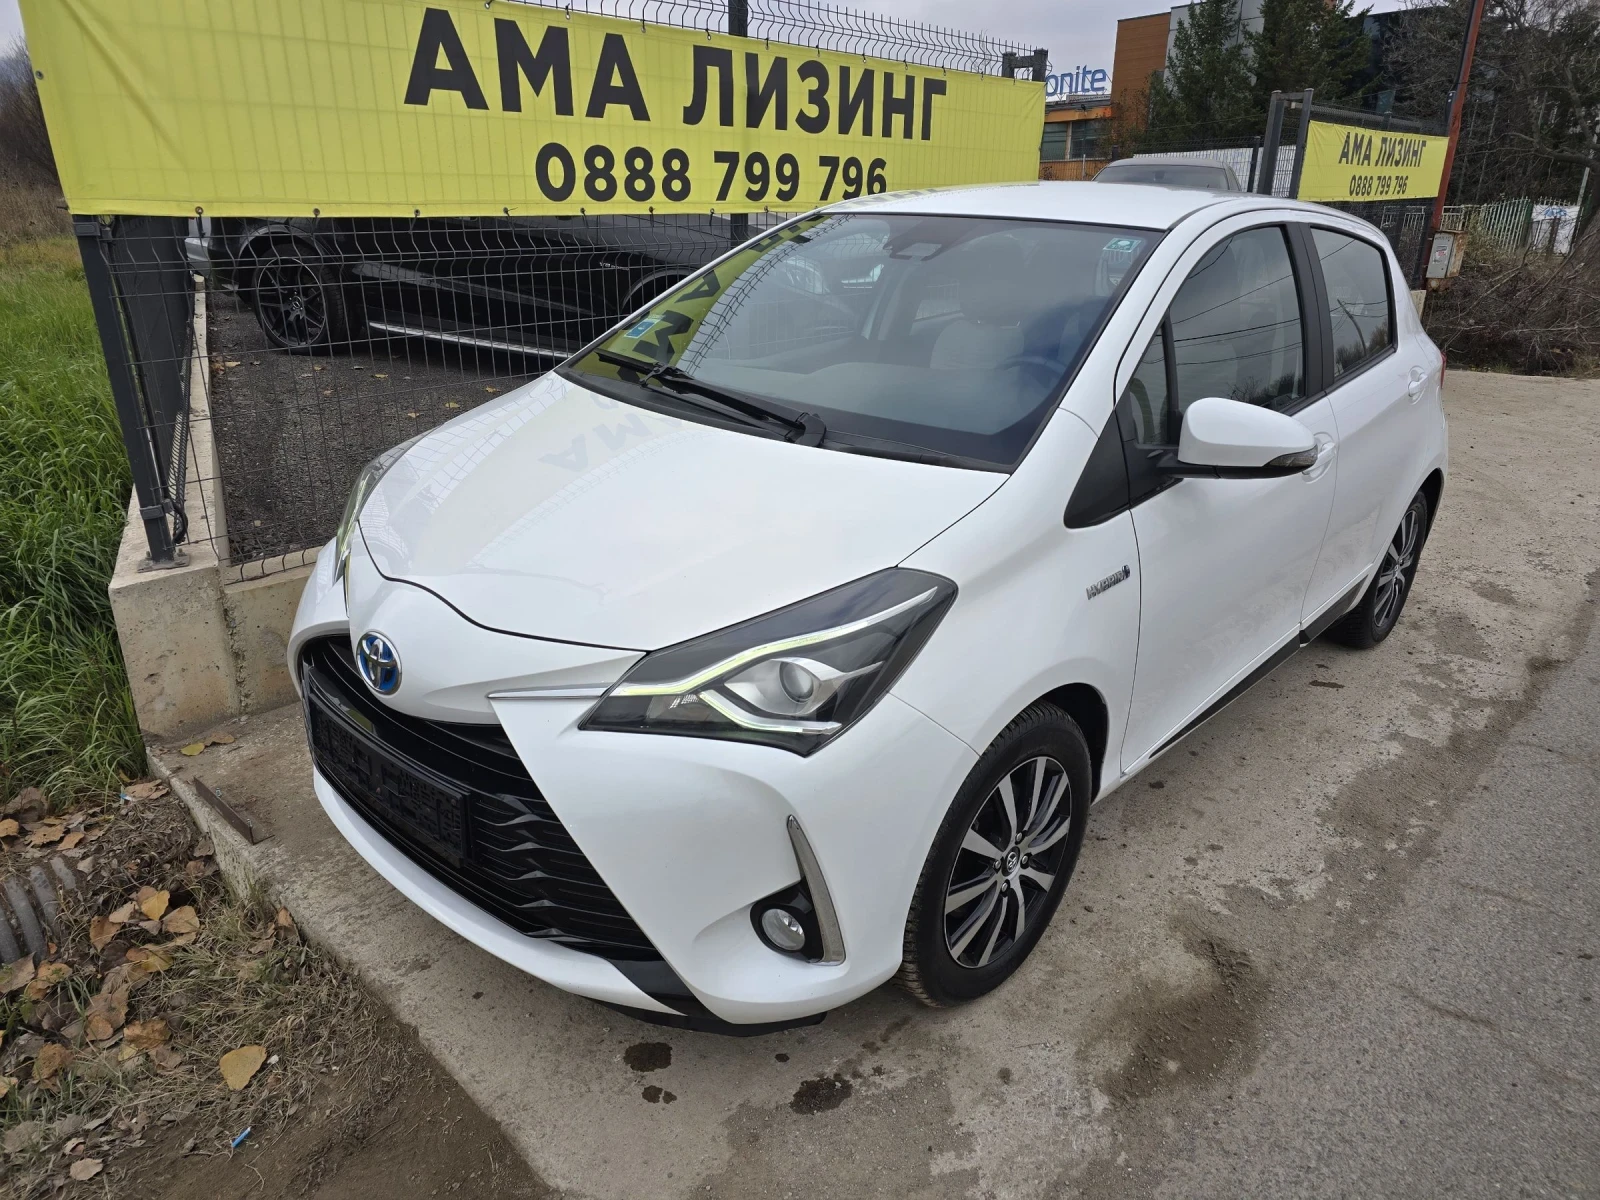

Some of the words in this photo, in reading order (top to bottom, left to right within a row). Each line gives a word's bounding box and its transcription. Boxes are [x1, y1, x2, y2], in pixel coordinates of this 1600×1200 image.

[404, 7, 650, 121] АМА
[683, 44, 947, 141] ЛИЗИНГ
[535, 142, 692, 203] 0888
[713, 151, 800, 203] 799
[817, 156, 887, 201] 796
[1338, 132, 1373, 167] АМА
[1375, 137, 1427, 168] ЛИЗИНГ
[1349, 174, 1374, 197] 0888
[1374, 175, 1392, 196] 799
[1392, 175, 1409, 195] 796
